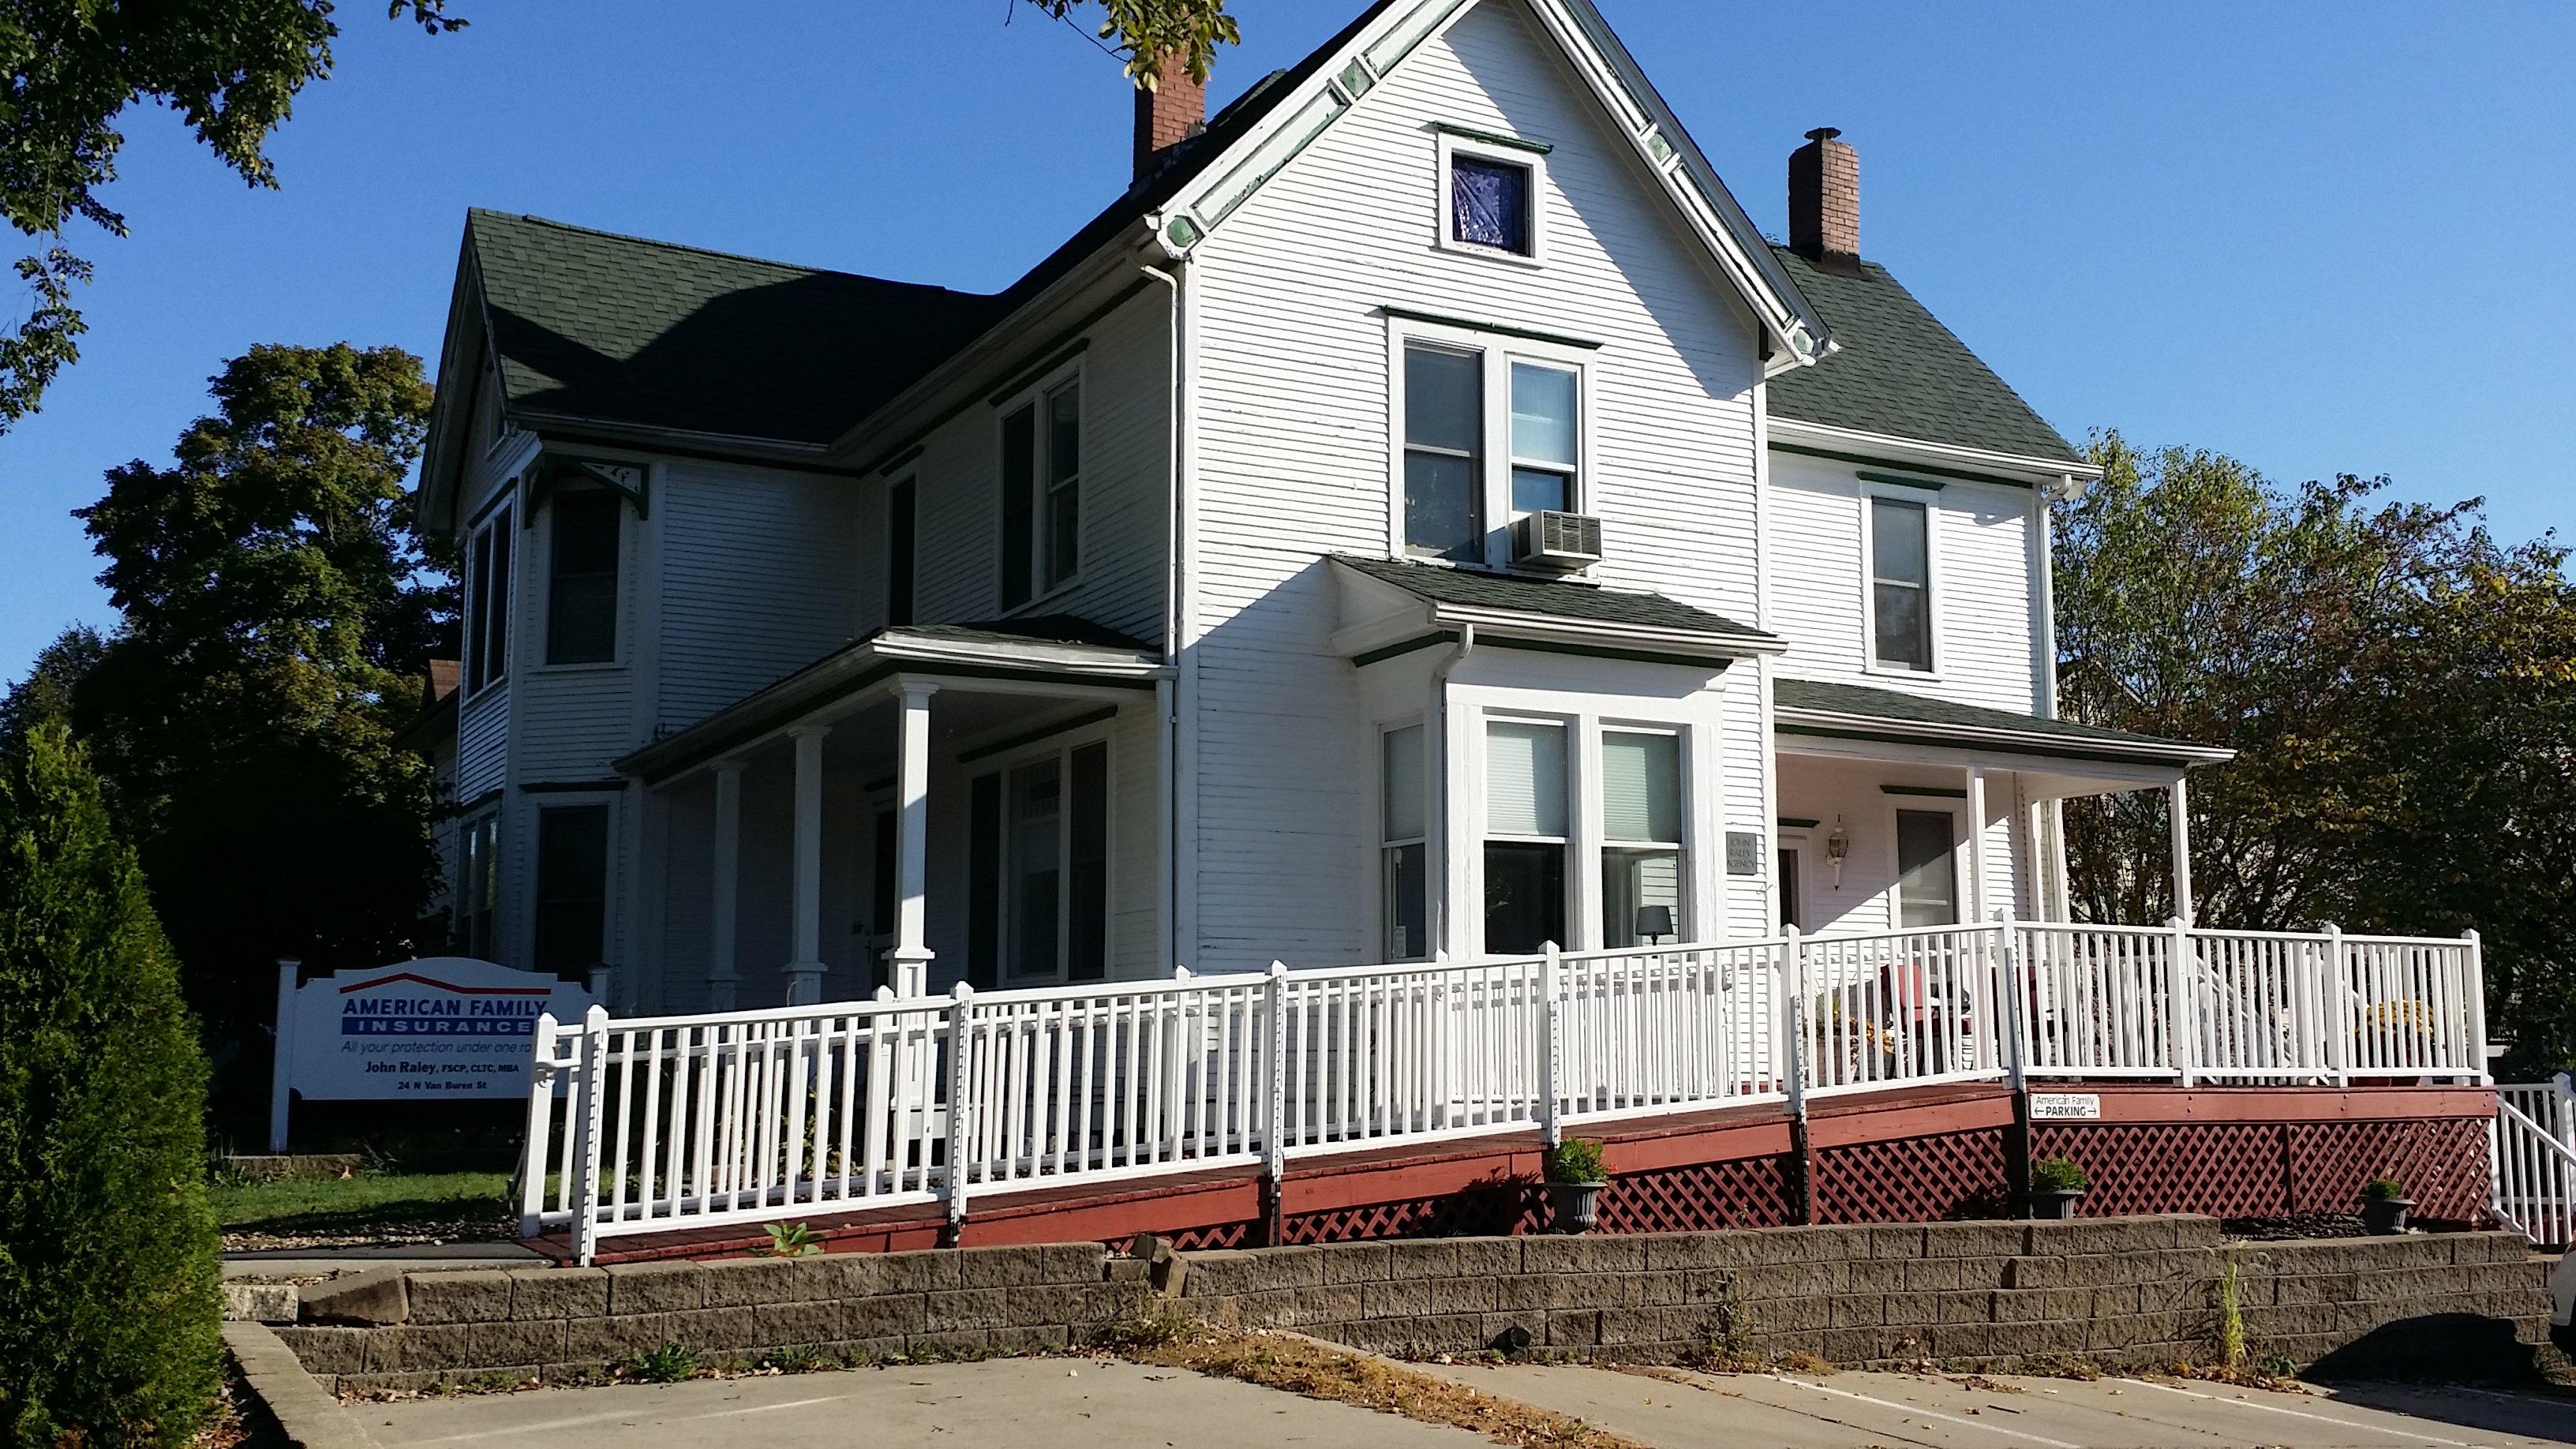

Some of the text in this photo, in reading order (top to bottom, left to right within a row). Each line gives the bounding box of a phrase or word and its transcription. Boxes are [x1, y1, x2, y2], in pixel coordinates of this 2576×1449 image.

[343, 998, 548, 1017] AMERICAN FAMILY
[358, 1020, 531, 1033] INSURANCE
[342, 1041, 533, 1055] All your protection under one ro
[365, 1061, 395, 1073] John
[400, 1061, 439, 1074] Raley,
[442, 1064, 469, 1074] FSCP,
[471, 1064, 496, 1074] CLTC,
[398, 1081, 410, 1090] 24
[2036, 1096, 2095, 1106] American Family
[2046, 1106, 2086, 1116] PARKING
